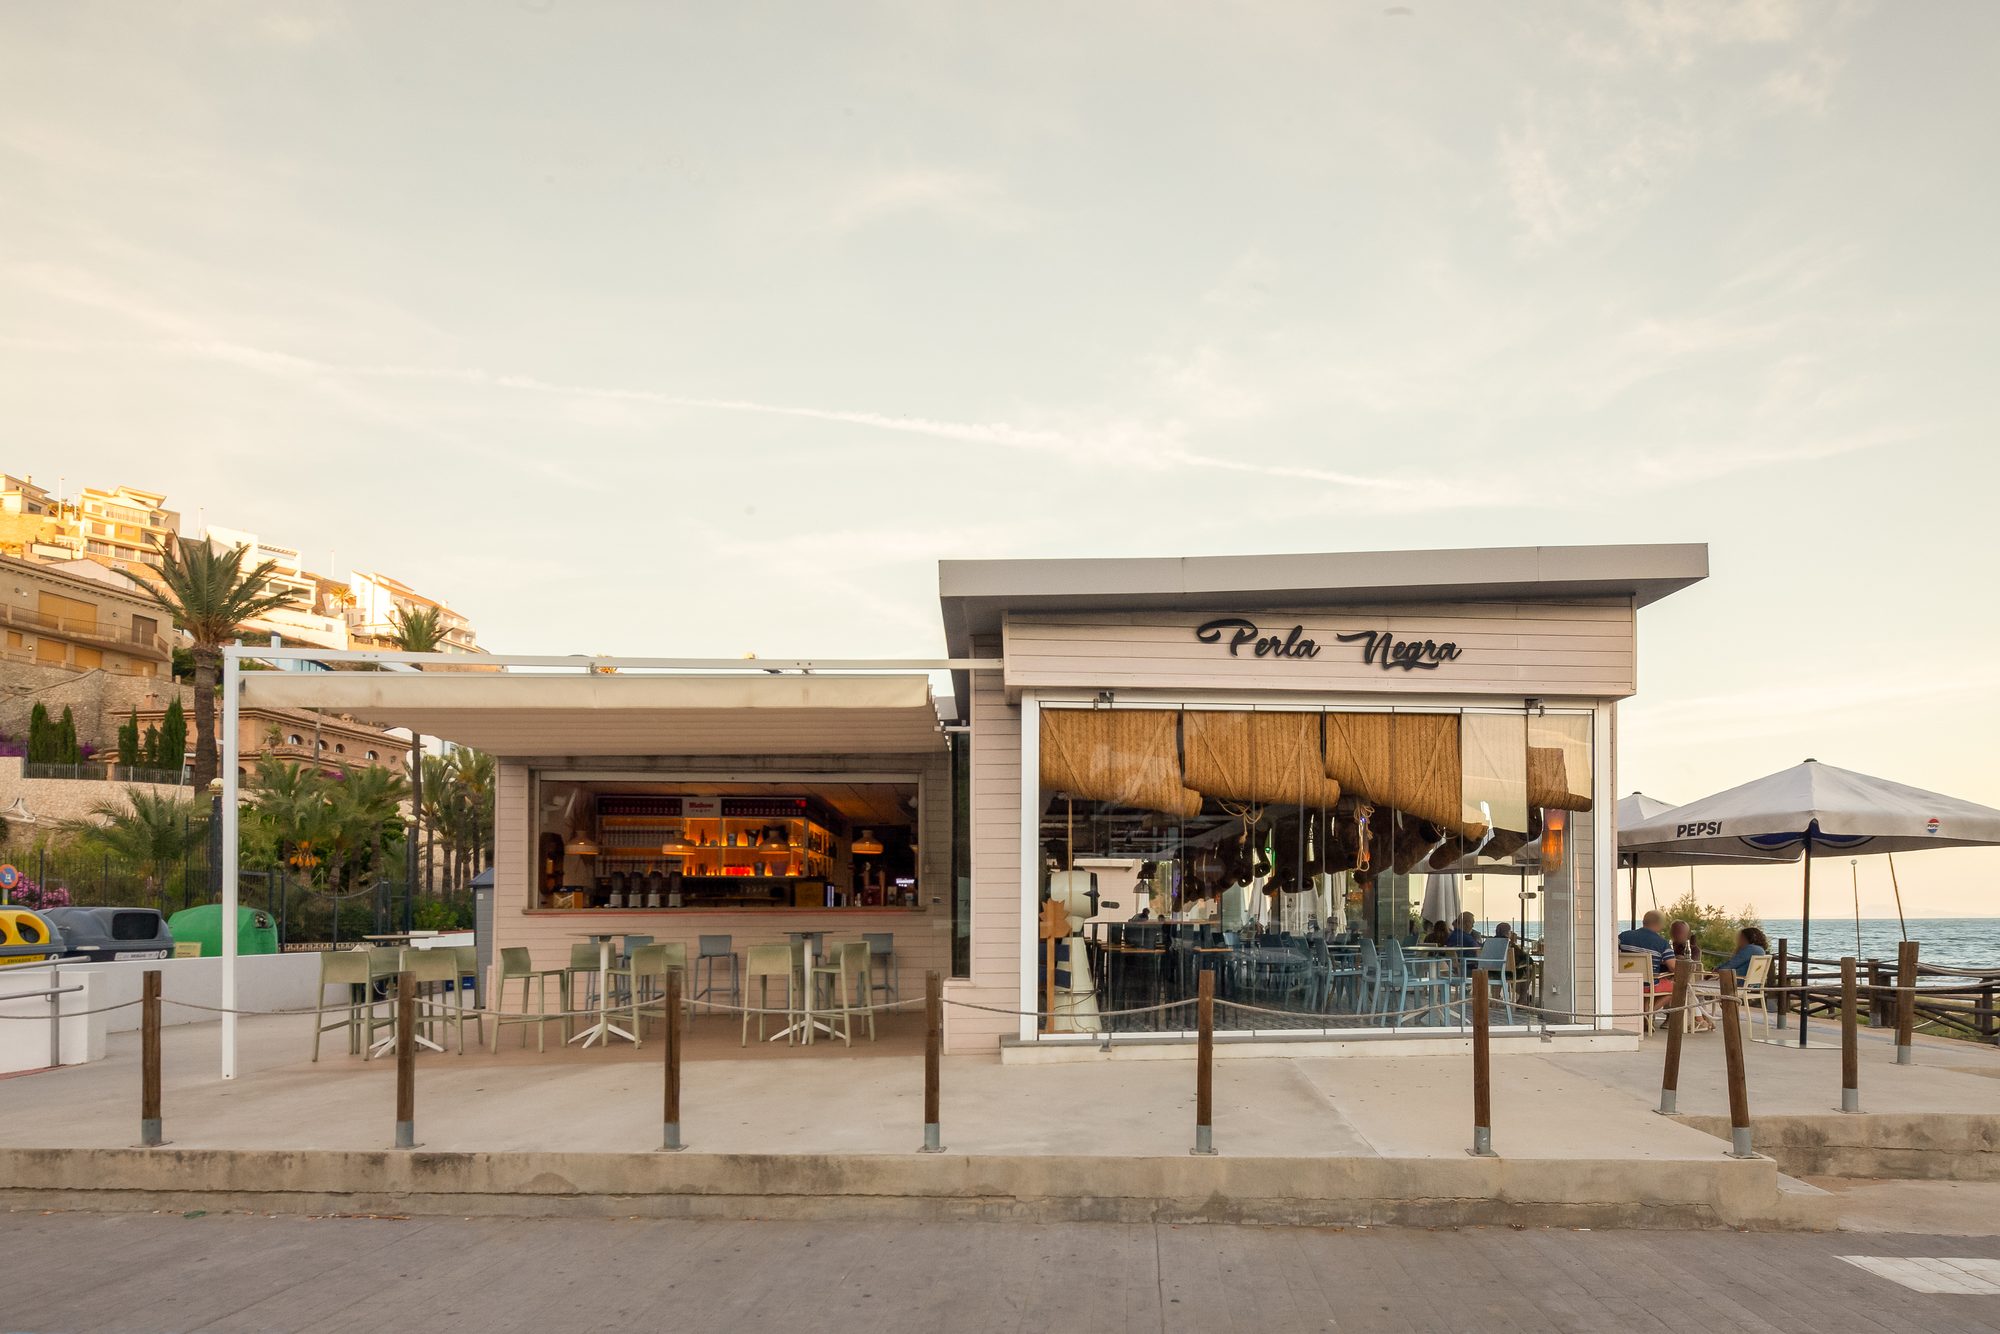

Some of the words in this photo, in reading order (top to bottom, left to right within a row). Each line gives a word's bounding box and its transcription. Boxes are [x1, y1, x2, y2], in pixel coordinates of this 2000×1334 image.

[1196, 618, 1321, 658] Perla
[1336, 630, 1463, 671] Negra
[1677, 821, 1722, 838] PEPSI
